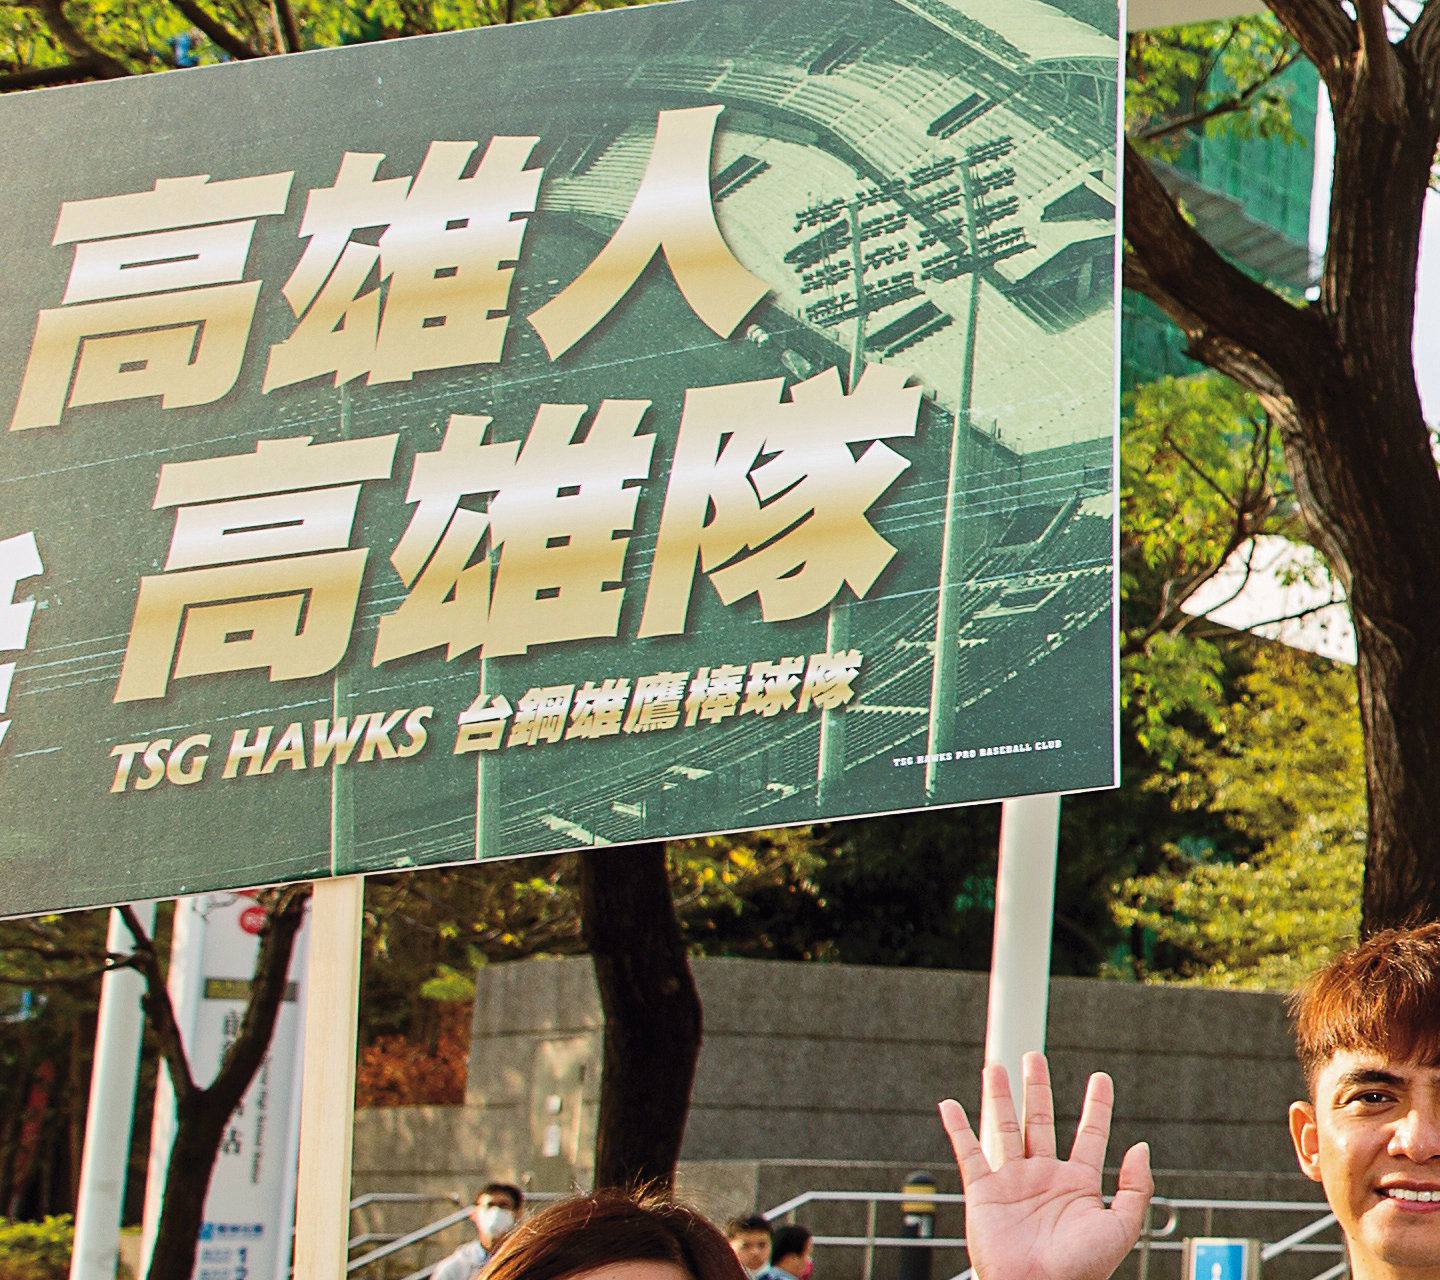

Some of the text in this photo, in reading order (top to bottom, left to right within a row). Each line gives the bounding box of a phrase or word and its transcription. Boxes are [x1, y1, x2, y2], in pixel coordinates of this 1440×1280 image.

[11, 104, 773, 433] 高雄人
[112, 363, 925, 705] 高雄隊
[109, 649, 865, 796] TSG HAWKS 台鋼雄鷹棒球隊
[955, 749, 976, 760] PRO
[979, 742, 1033, 758] BASEBALL
[1034, 739, 1063, 751] CLUB
